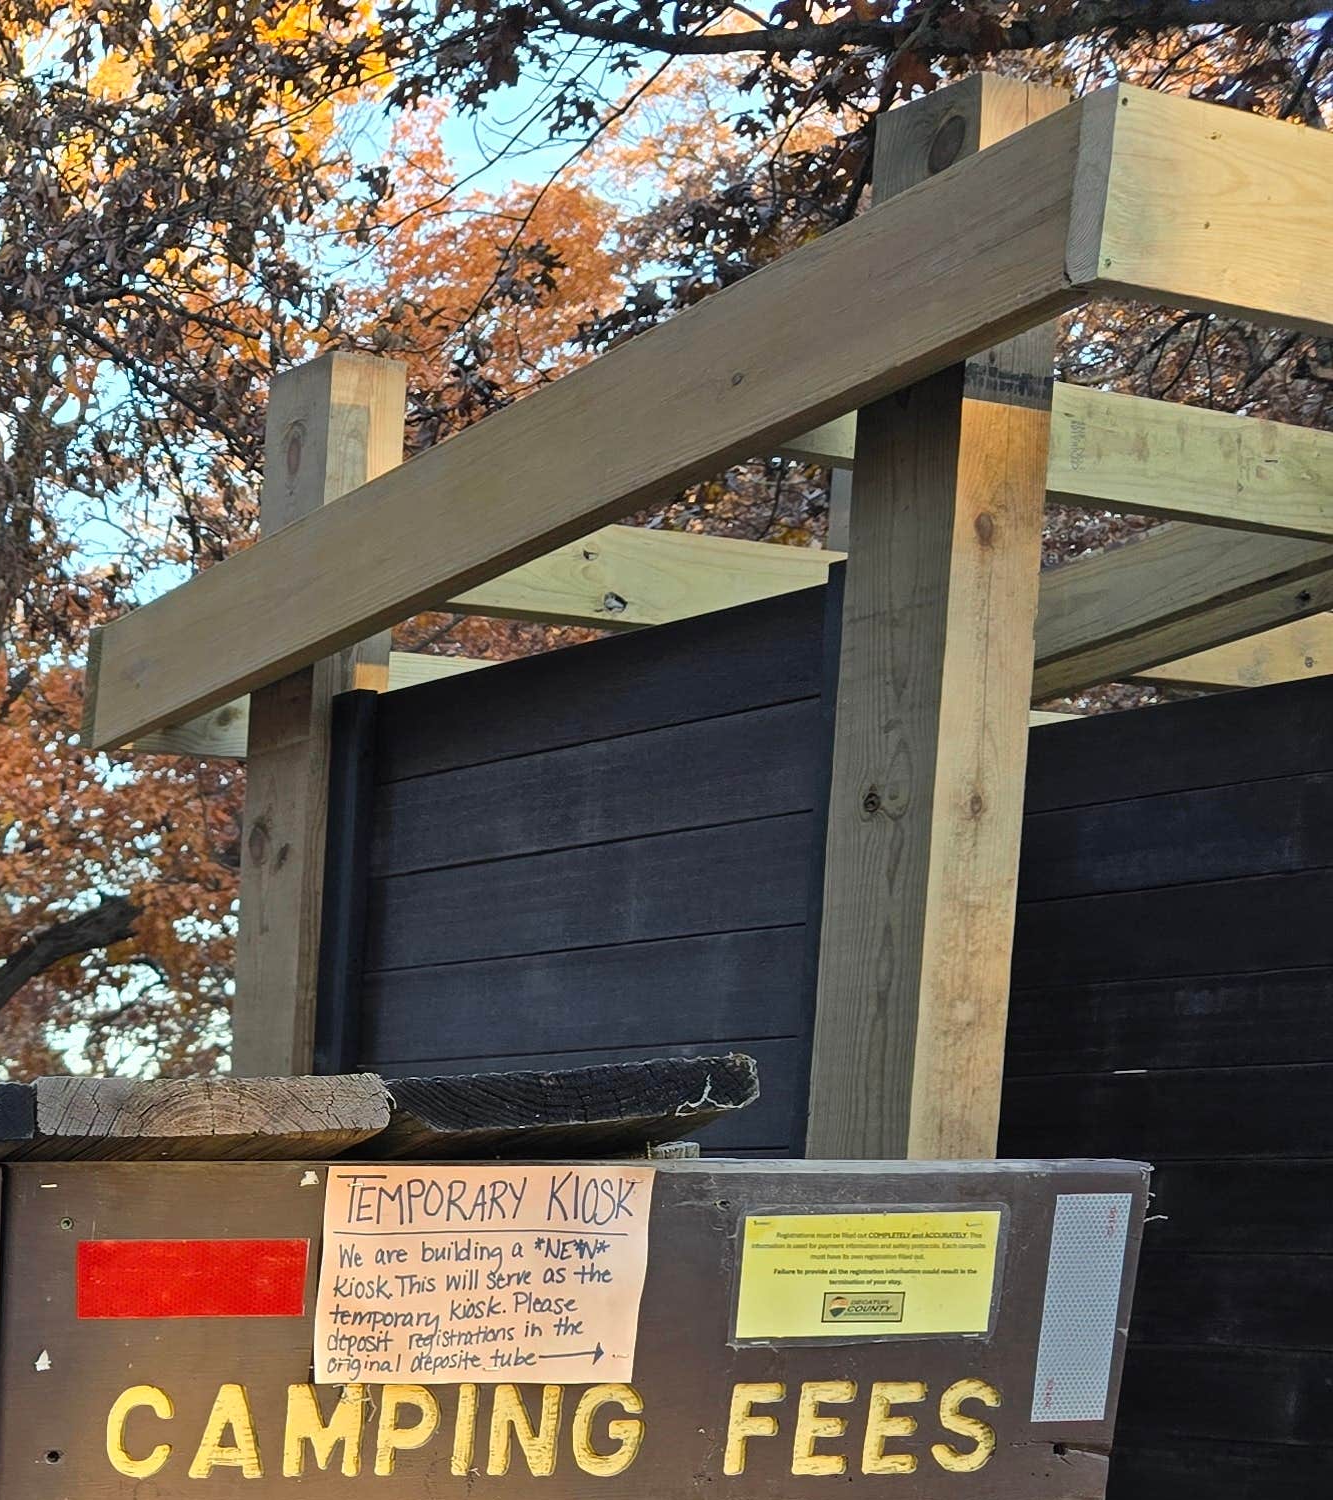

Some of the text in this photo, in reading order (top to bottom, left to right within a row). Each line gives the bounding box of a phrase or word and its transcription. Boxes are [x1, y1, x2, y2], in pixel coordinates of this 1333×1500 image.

[337, 1171, 635, 1226] TEMPORARY KIOSK
[339, 1243, 363, 1268] We
[375, 1248, 408, 1265] are
[421, 1238, 502, 1273] building
[511, 1242, 524, 1258] a
[395, 1274, 437, 1297] This
[446, 1269, 479, 1291] will
[486, 1270, 532, 1290] serve
[543, 1267, 567, 1284] as
[573, 1262, 613, 1284] the
[329, 1304, 440, 1334] temporary
[513, 1291, 579, 1315] Please
[327, 1316, 584, 1356] deposit registrations in the
[327, 1347, 537, 1381] original deposite tube
[105, 1377, 1002, 1479] CAMPING FEES
